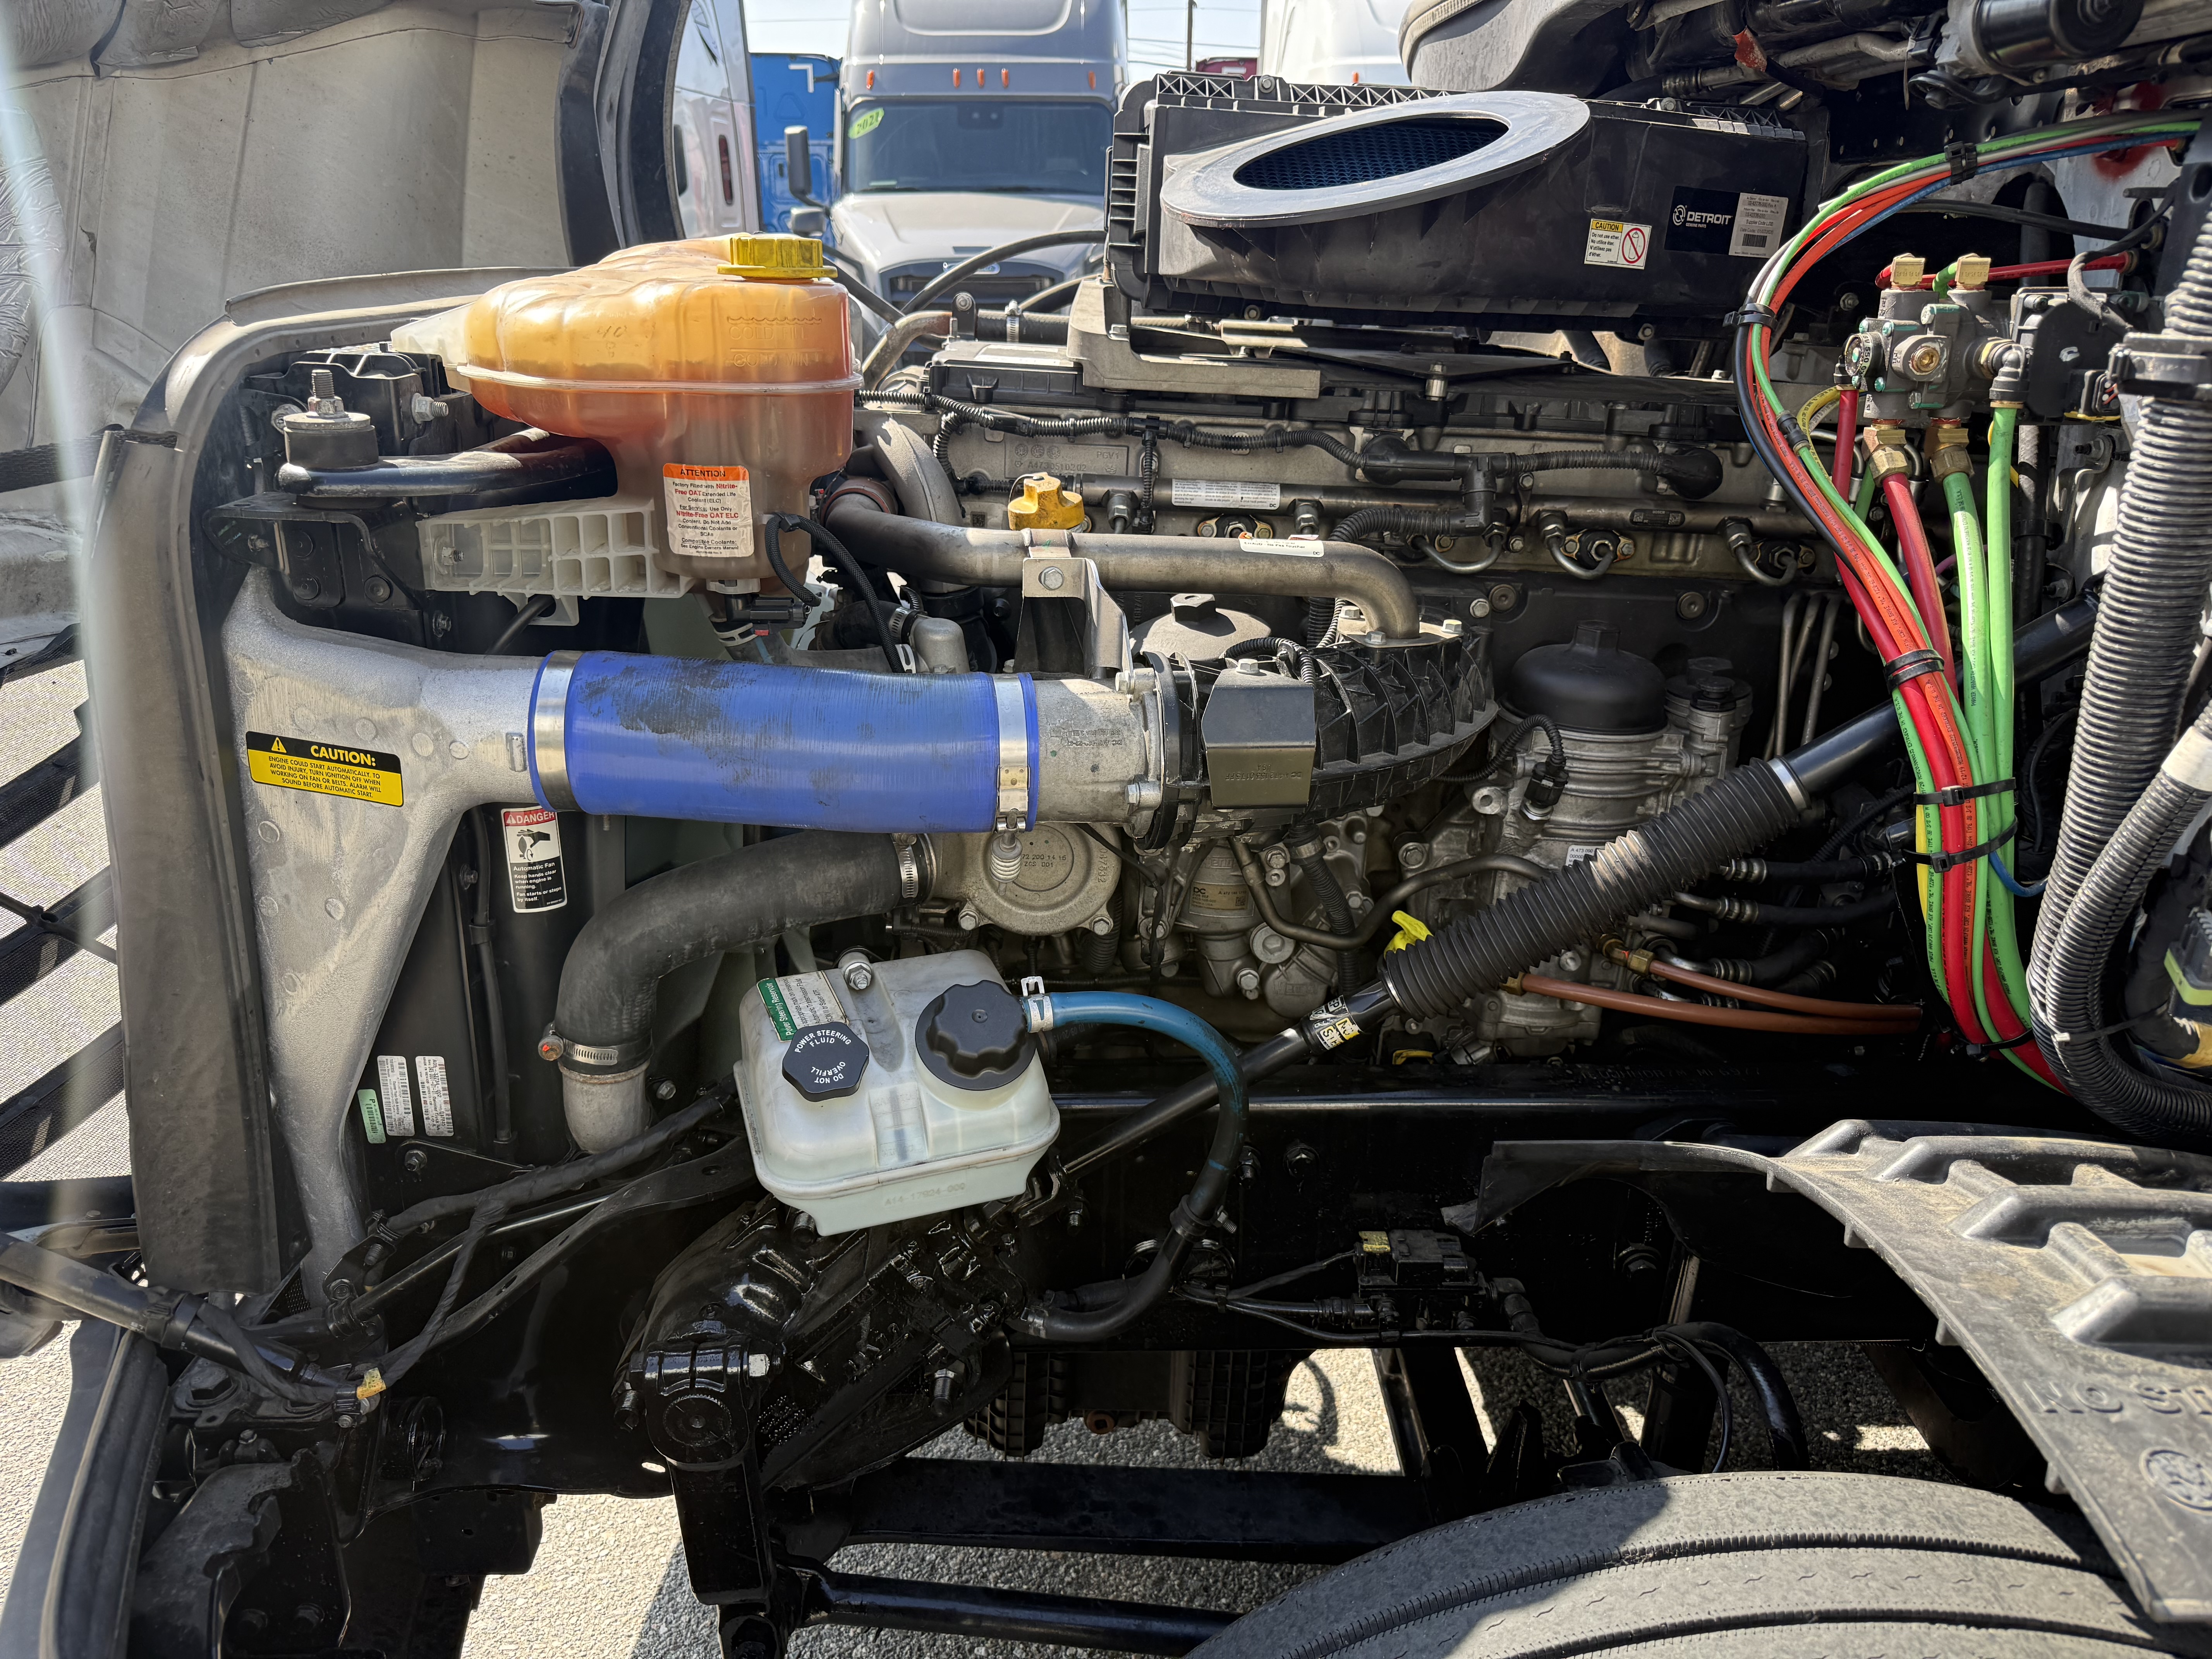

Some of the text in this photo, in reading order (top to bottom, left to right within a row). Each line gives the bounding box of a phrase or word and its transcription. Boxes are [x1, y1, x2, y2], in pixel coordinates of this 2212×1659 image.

[1686, 211, 1731, 225] DETROIT
[1595, 222, 1619, 230] CAUTION
[729, 326, 807, 340] COLD FILL
[734, 353, 808, 367] COLD MIN
[1862, 346, 1872, 363] 550
[680, 469, 725, 477] ATTENTION
[311, 745, 376, 766] CAUTION:
[271, 770, 297, 778] WORKING
[288, 766, 307, 774] INJURY,
[325, 772, 350, 780] IGNITION
[325, 785, 355, 794] AUTOMATIC
[517, 812, 555, 823] DANGER
[1098, 848, 1108, 883] 047532
[783, 977, 793, 992] reservoir
[795, 977, 804, 987] Fluid
[790, 996, 799, 1006] mark
[817, 995, 826, 1006] Super
[764, 981, 794, 1036] Power Steering Reservoir
[795, 1030, 851, 1053] POWER STEERING
[810, 1037, 835, 1047] FLUID
[811, 1061, 846, 1076] OVERFILL
[833, 1073, 844, 1081] DO
